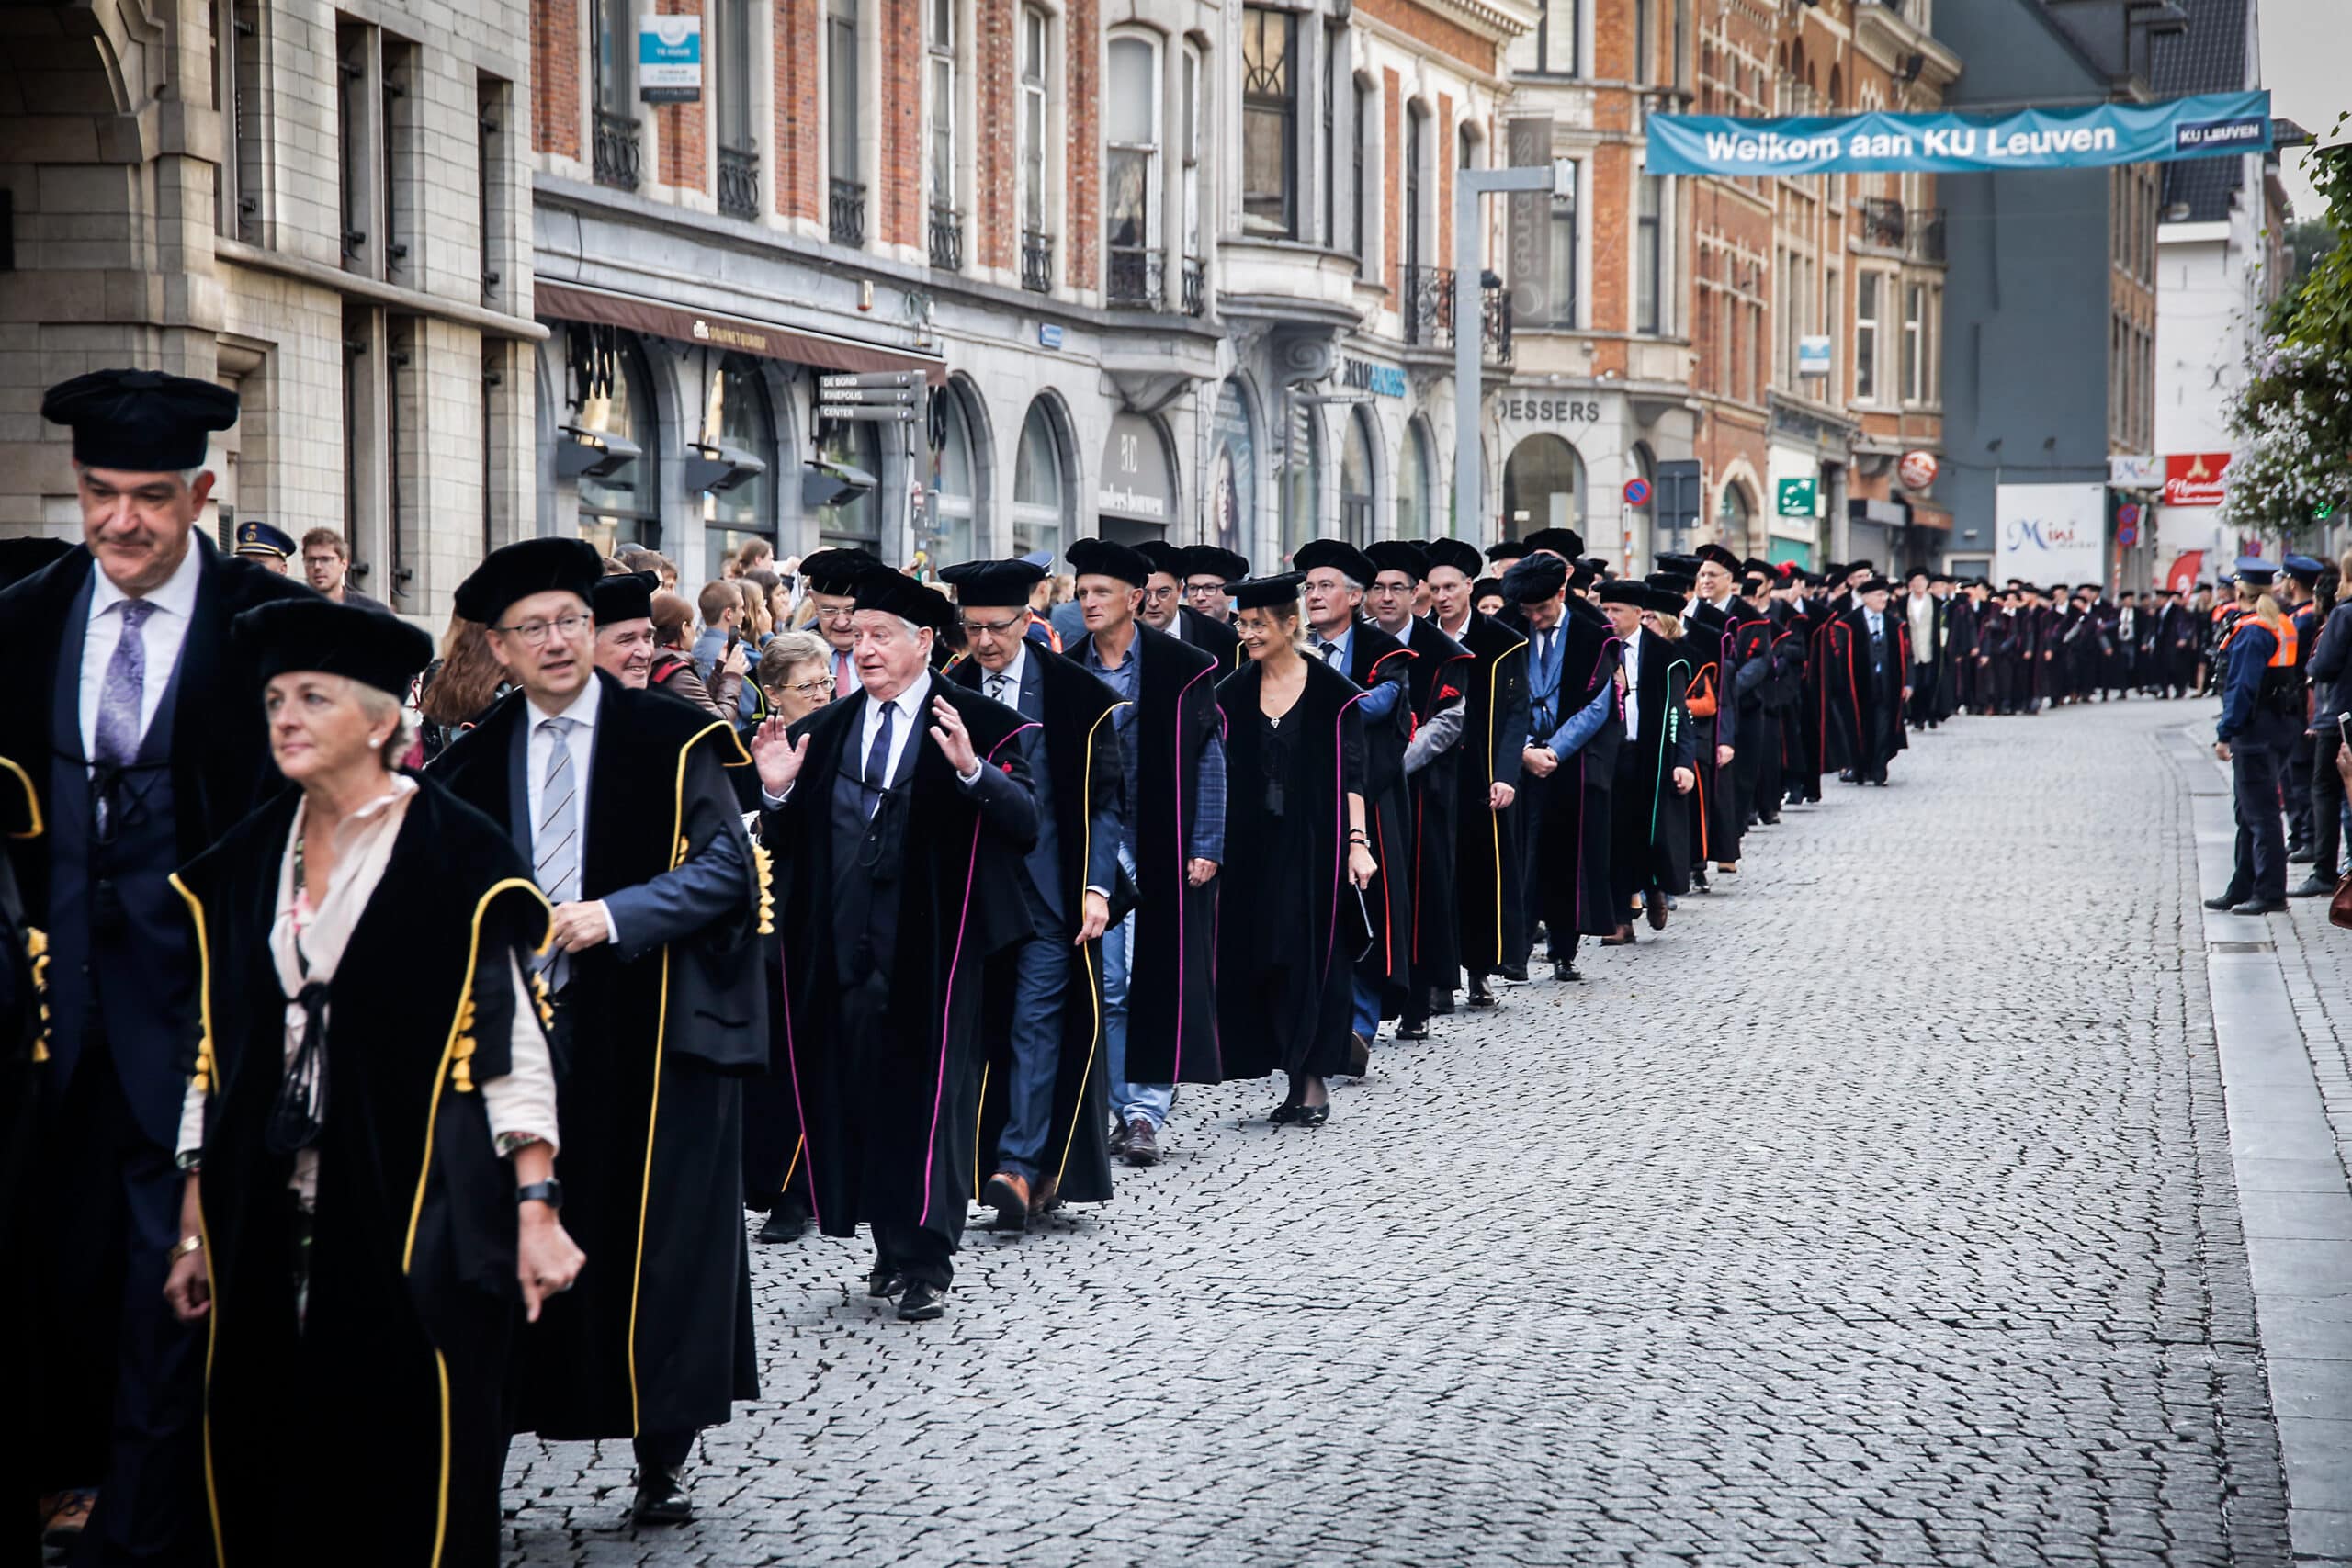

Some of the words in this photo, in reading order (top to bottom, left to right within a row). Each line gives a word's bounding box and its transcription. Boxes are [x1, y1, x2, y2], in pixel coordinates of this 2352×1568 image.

[2179, 130, 2201, 143] KU
[2203, 123, 2259, 142] LEUVEN
[1705, 131, 1840, 163] Welkom
[1849, 133, 1913, 159] aan
[1923, 129, 1976, 158] KU
[1986, 127, 2116, 158] Leuven
[823, 378, 833, 388] DE
[835, 377, 857, 386] BOND
[823, 390, 863, 401] KINEPOLIS
[823, 407, 854, 418] CENTER
[2007, 517, 2076, 551] Mini
